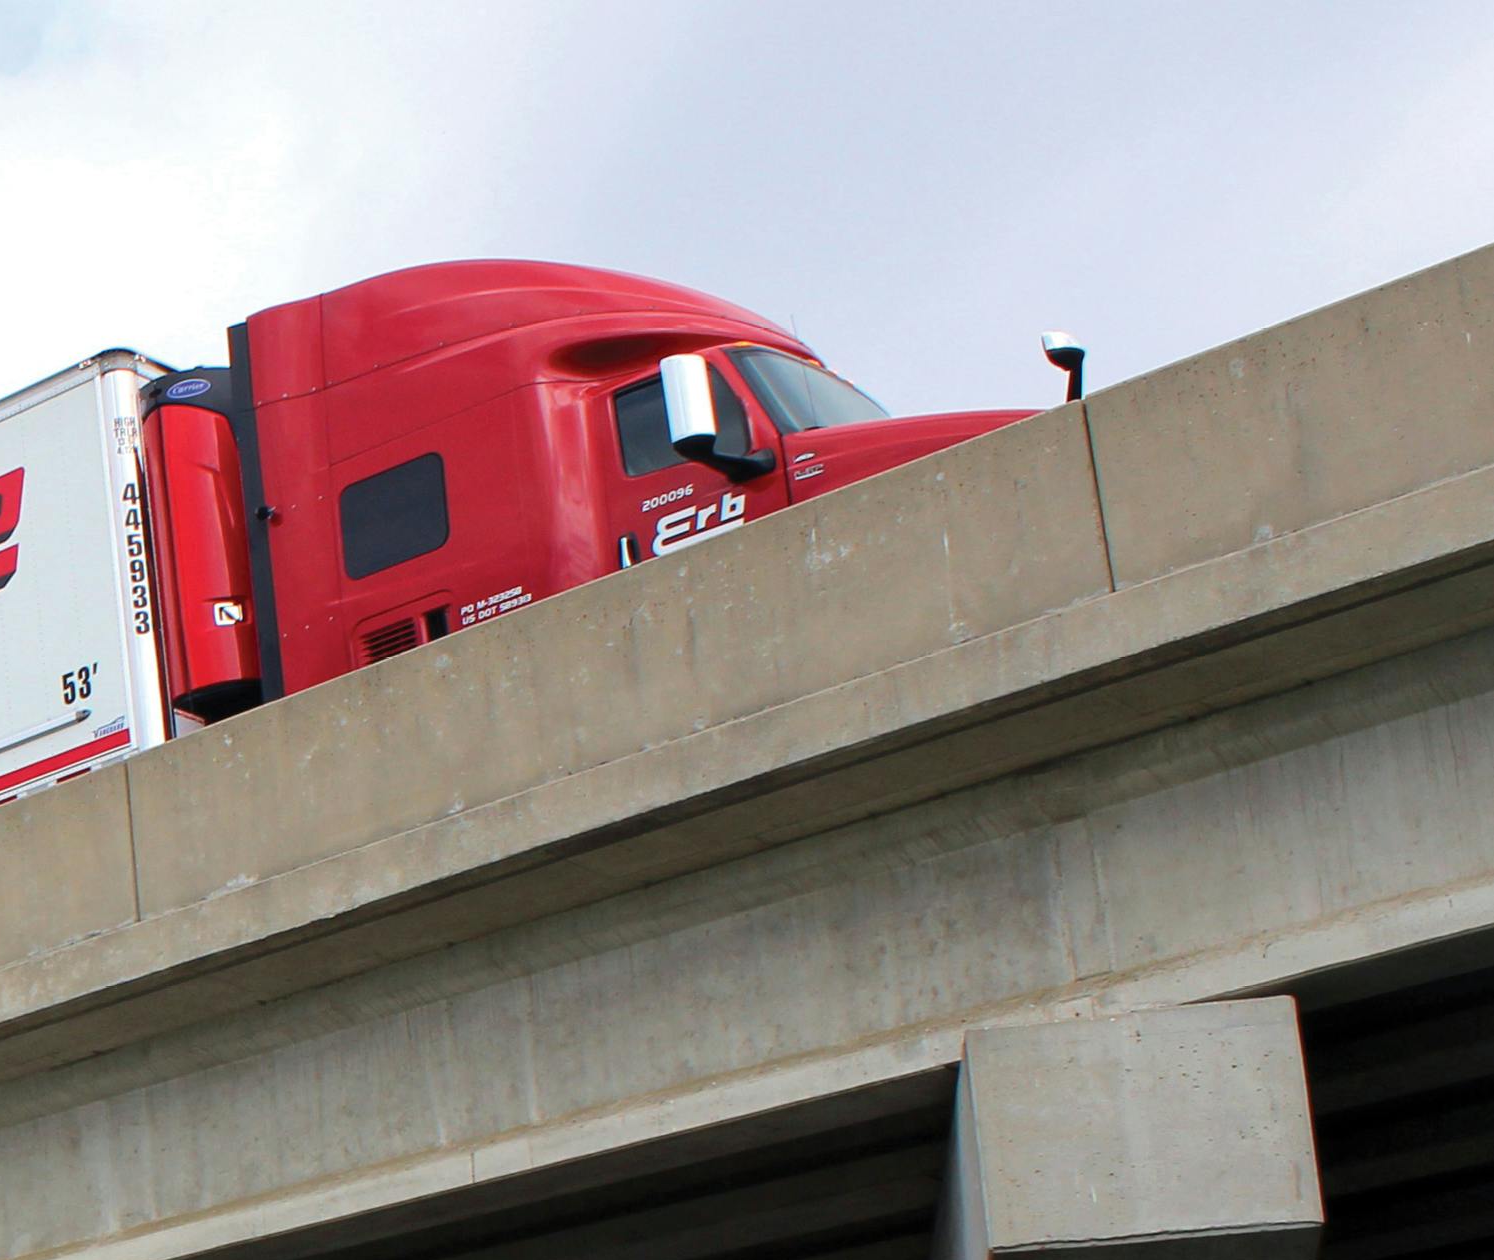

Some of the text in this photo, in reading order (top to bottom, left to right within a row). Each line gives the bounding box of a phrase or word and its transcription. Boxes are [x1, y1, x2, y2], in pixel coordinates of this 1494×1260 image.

[172, 382, 206, 395] Carrier
[641, 483, 694, 512] 200096
[652, 492, 746, 557] Erb
[122, 483, 150, 634] 445933
[462, 614, 476, 625] US
[478, 606, 498, 619] DOT
[62, 662, 98, 705] 53'
